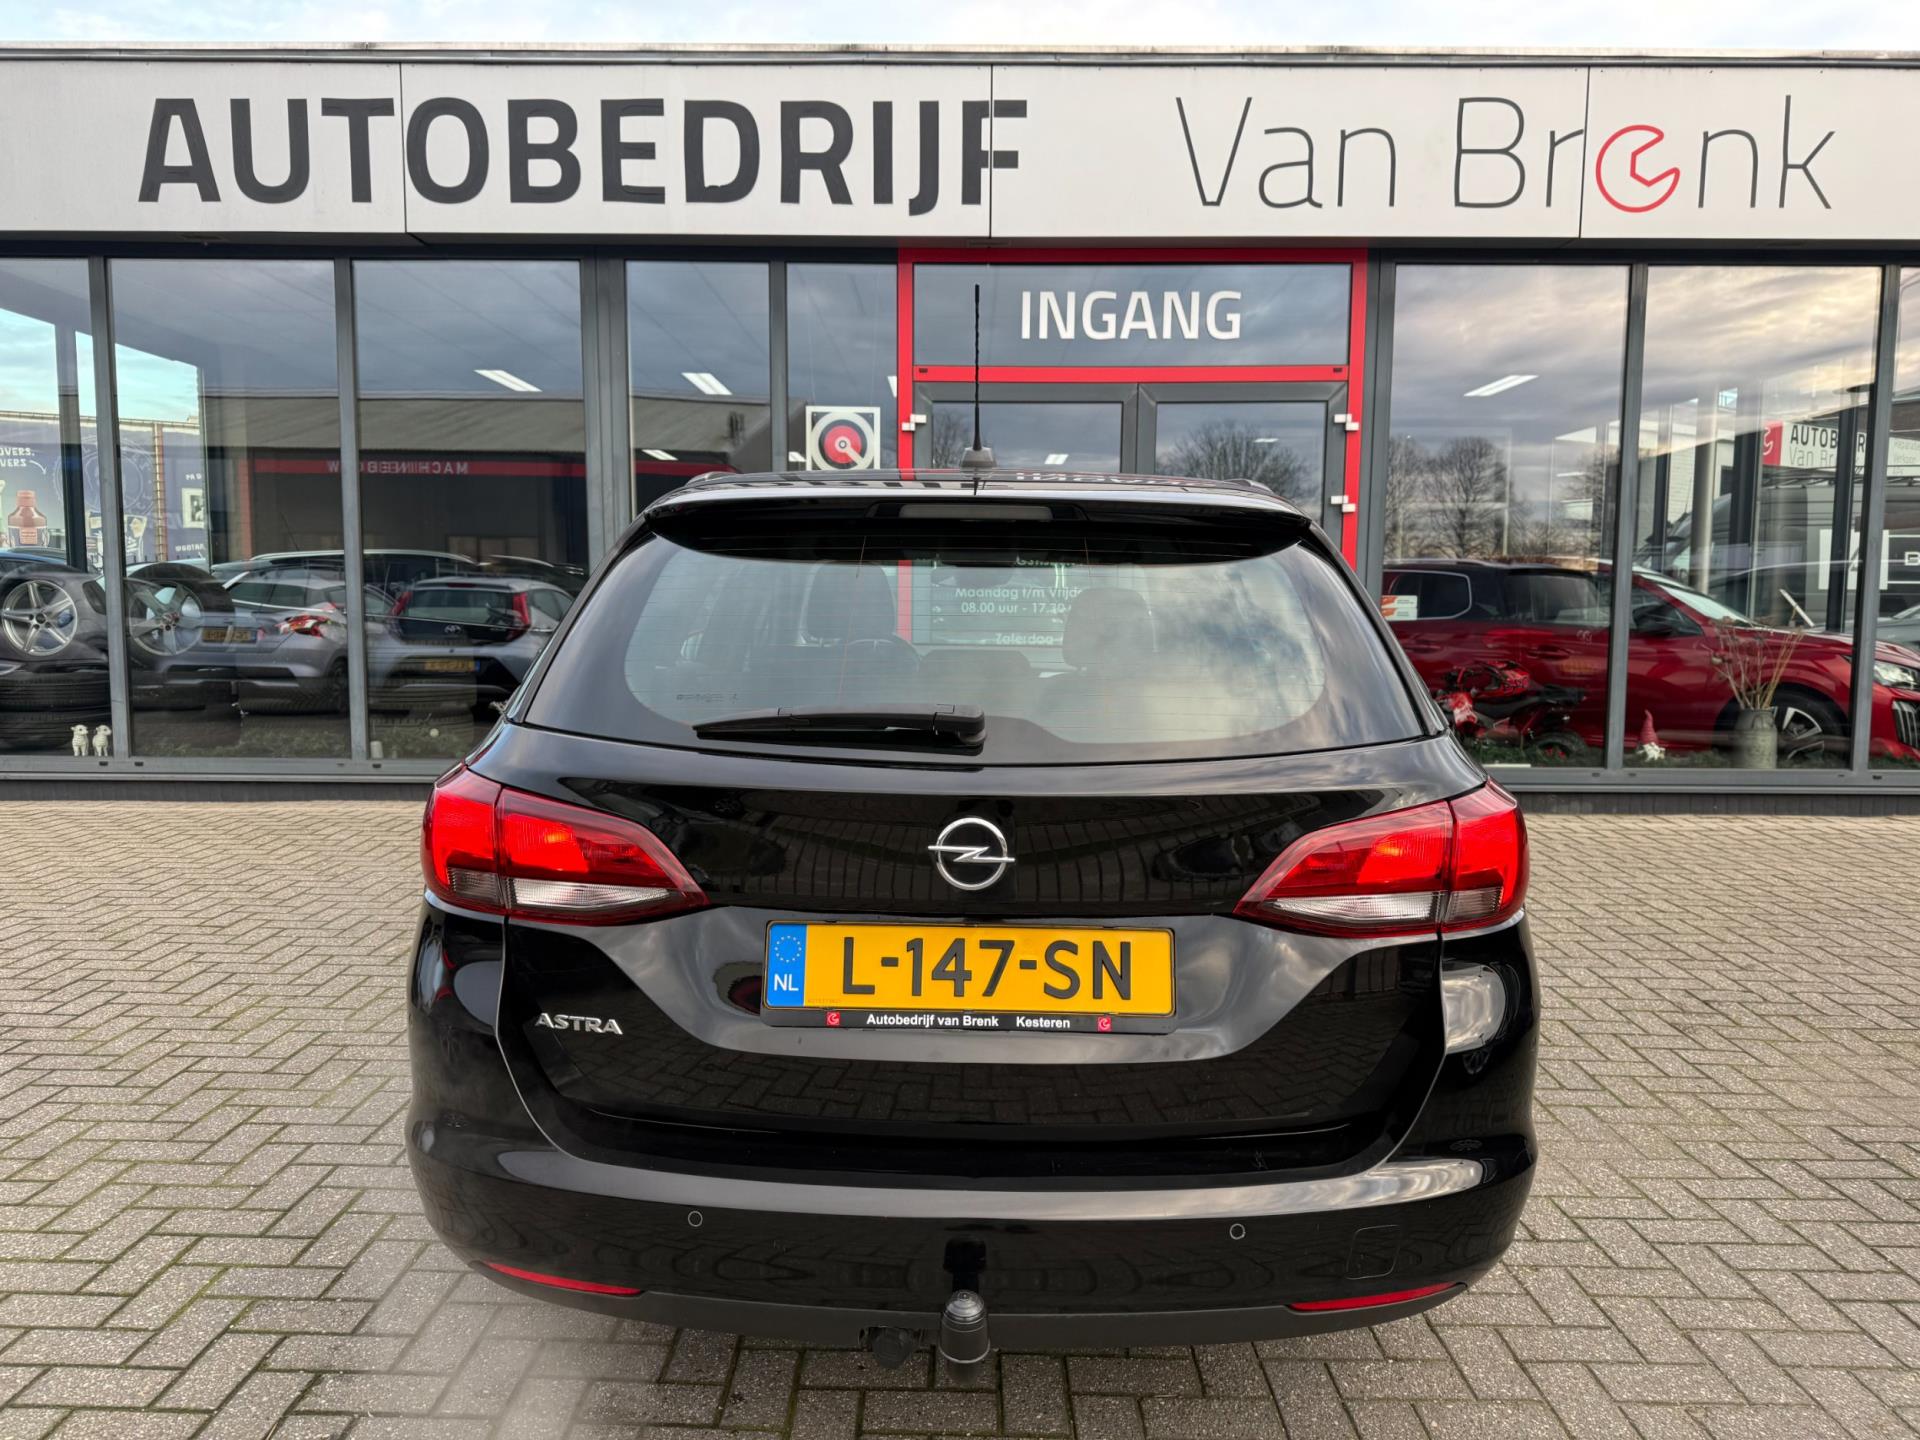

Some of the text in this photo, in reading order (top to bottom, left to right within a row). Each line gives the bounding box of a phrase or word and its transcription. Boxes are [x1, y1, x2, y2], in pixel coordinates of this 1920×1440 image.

[137, 96, 1029, 217] AUTOBEDRIJF
[1175, 96, 1397, 209] Van
[1020, 290, 1242, 340] INGANG
[955, 587, 1019, 600] Maandag
[1022, 587, 1045, 599] t/m
[961, 602, 995, 613] 08.00
[998, 604, 1018, 613] uur
[843, 936, 1131, 1000] L-147-SN
[773, 973, 799, 991] NL
[535, 1012, 624, 1035] ASTRA
[866, 1013, 1071, 1029] Autobedrijf van Brenk Kesteren
